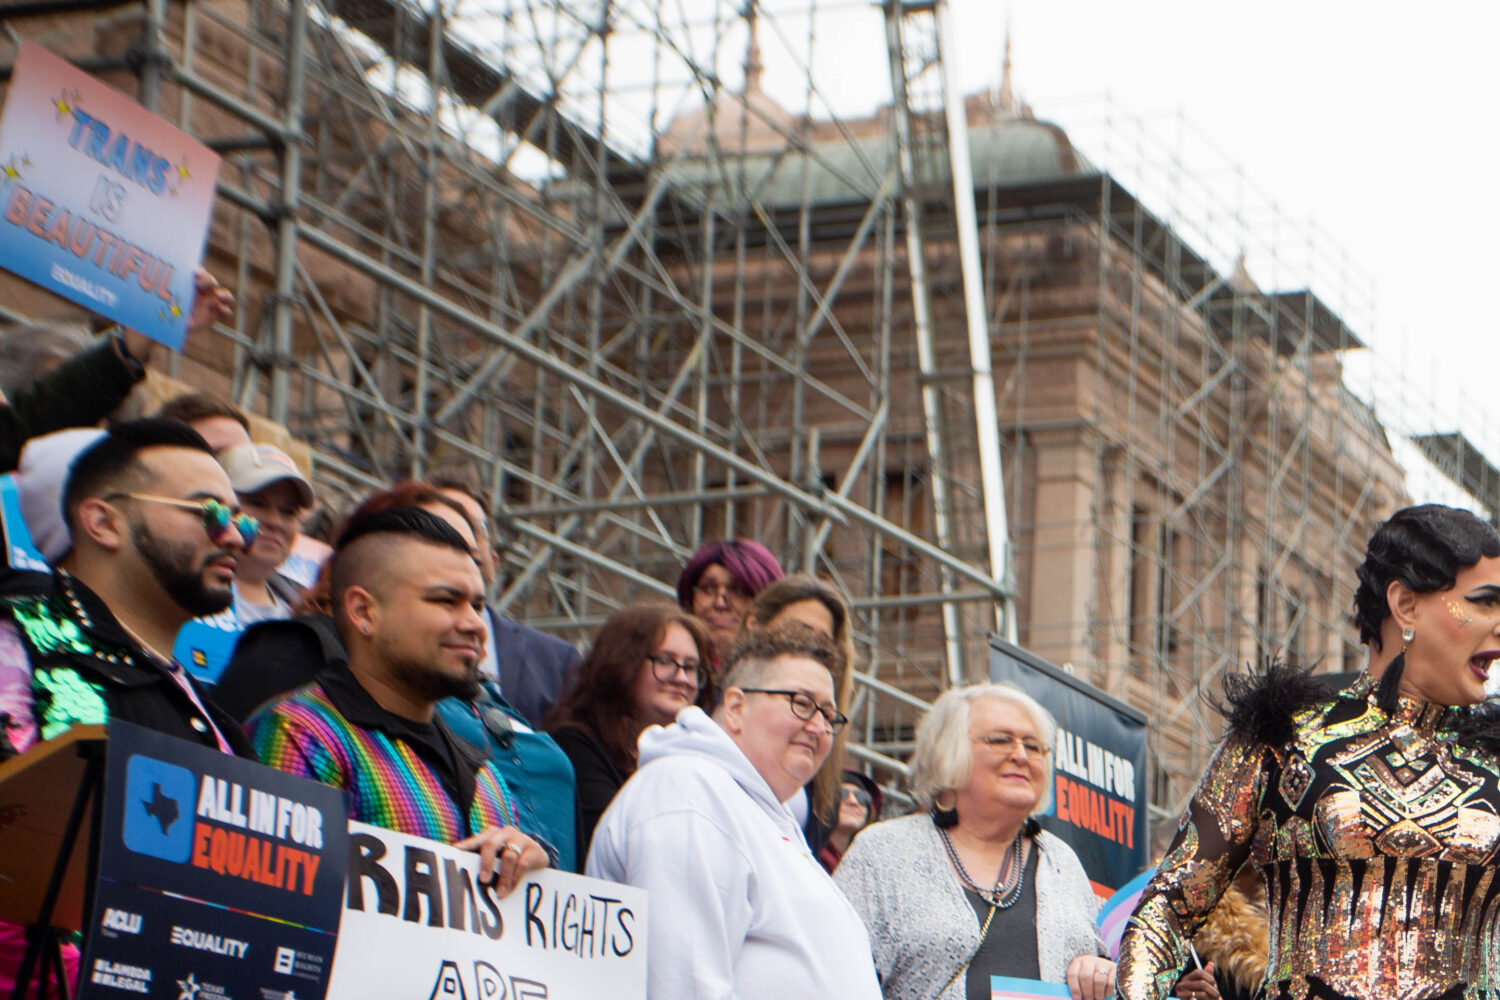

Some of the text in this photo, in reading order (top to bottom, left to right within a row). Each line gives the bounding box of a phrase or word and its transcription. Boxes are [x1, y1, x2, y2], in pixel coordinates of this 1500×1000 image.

[68, 106, 170, 196] TRANS
[90, 173, 126, 224] IS
[3, 184, 176, 304] BEAUTIFUL
[1055, 727, 1135, 802] ALL IN FOR
[197, 774, 324, 850] ALL IN FOR
[1055, 774, 1135, 849] EQUALITY
[192, 821, 321, 897] EQUALITY
[101, 907, 143, 935] ACLU
[169, 925, 249, 960] EQUALITY
[525, 881, 635, 959] RIGHTS
